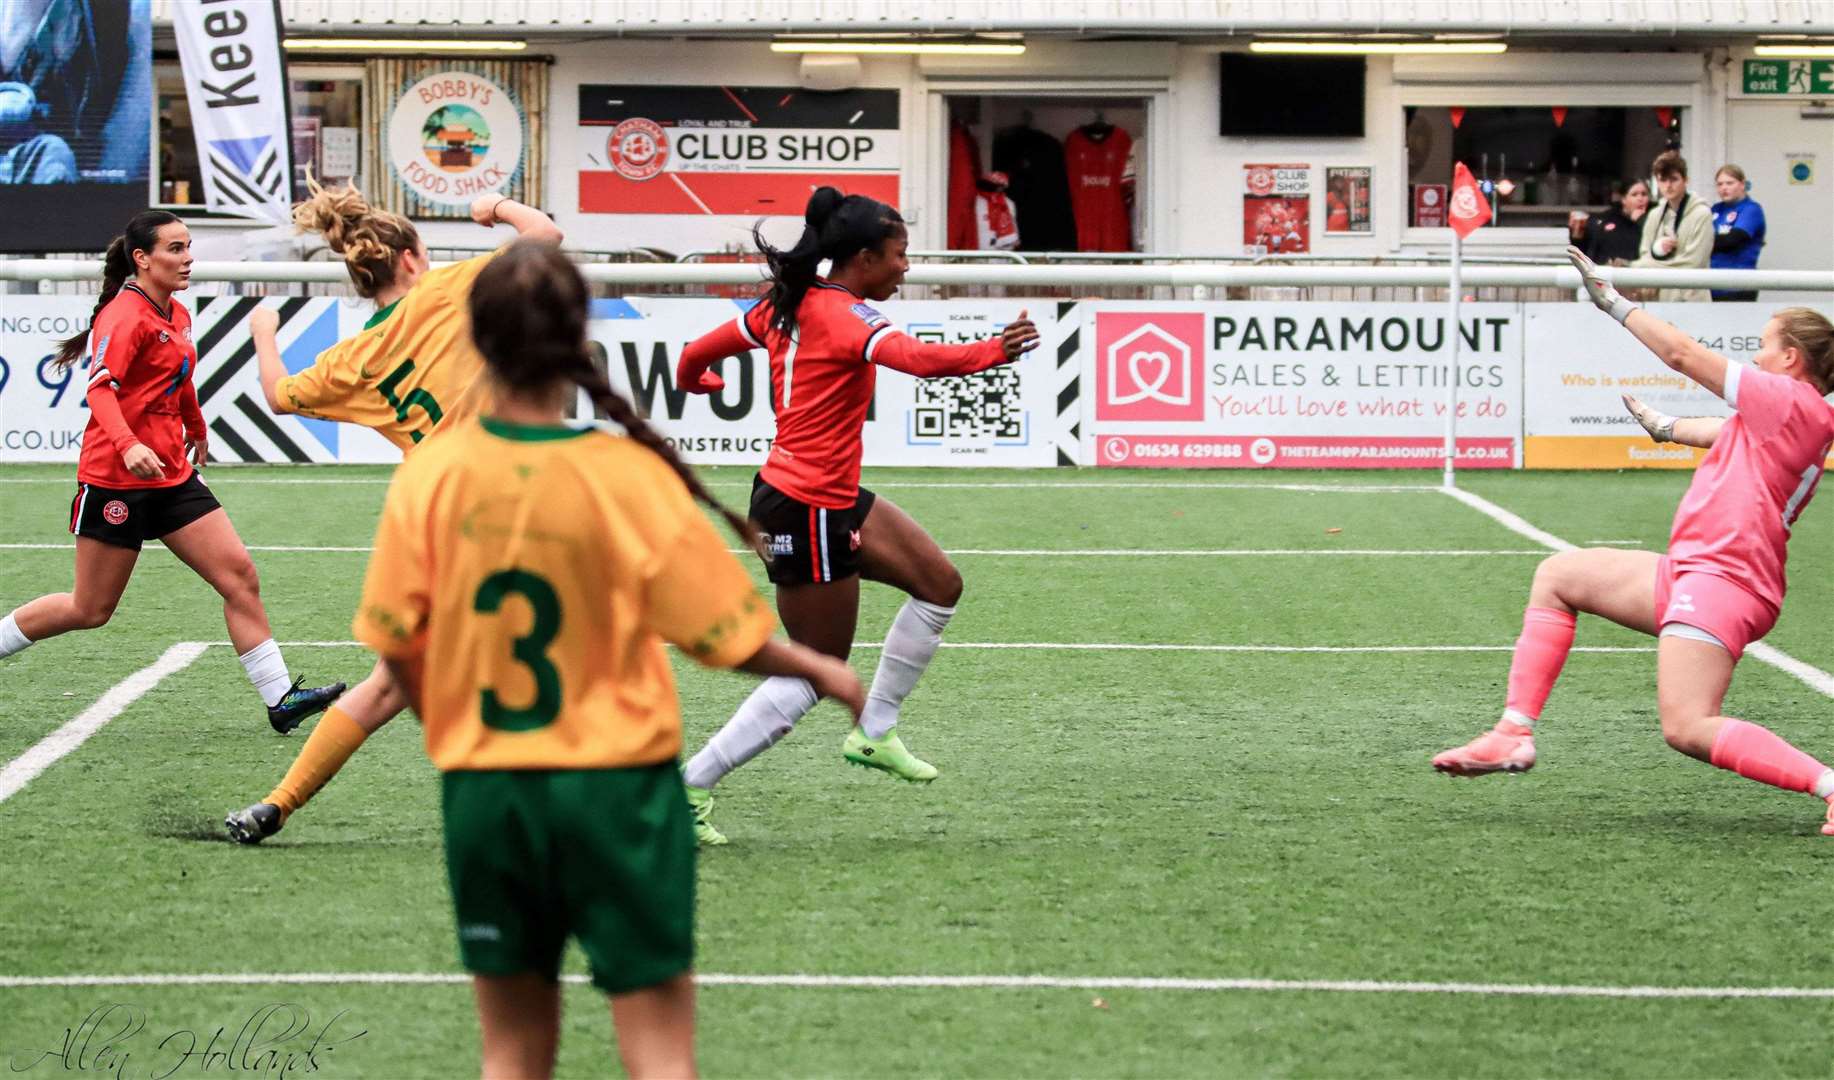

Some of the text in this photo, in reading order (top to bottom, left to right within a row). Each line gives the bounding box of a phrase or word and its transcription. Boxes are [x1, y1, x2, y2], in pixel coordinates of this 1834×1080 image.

[200, 0, 260, 109] Kee
[1749, 62, 1779, 76] Fire
[418, 79, 493, 105] BOBBY'S
[1749, 78, 1779, 91] exit
[708, 119, 728, 128] AND
[677, 133, 874, 161] CLUB SHOP
[403, 160, 508, 196] FOOD SHACK
[1277, 171, 1307, 180] CLUB
[1277, 182, 1309, 191] SHOP
[2, 316, 93, 334] NG.CO.U
[1213, 316, 1510, 352] PARAMOUNT
[1730, 336, 1764, 351] SE
[1212, 364, 1307, 387] SALES
[1321, 364, 1341, 387] &
[1561, 373, 1596, 386] Who
[1601, 374, 1613, 386] is
[1618, 373, 1687, 390] watching
[376, 357, 443, 444] 5
[1212, 395, 1287, 419] You'll
[1296, 396, 1347, 416] love
[1357, 397, 1424, 417] what
[1475, 396, 1508, 418] do
[1134, 444, 1242, 457] 01634 629888
[1279, 446, 1508, 458] THETEAM@PARAMOUNTSL.CO.UK
[1628, 446, 1695, 460] facebook
[774, 534, 792, 543] M2
[473, 568, 563, 732] 3
